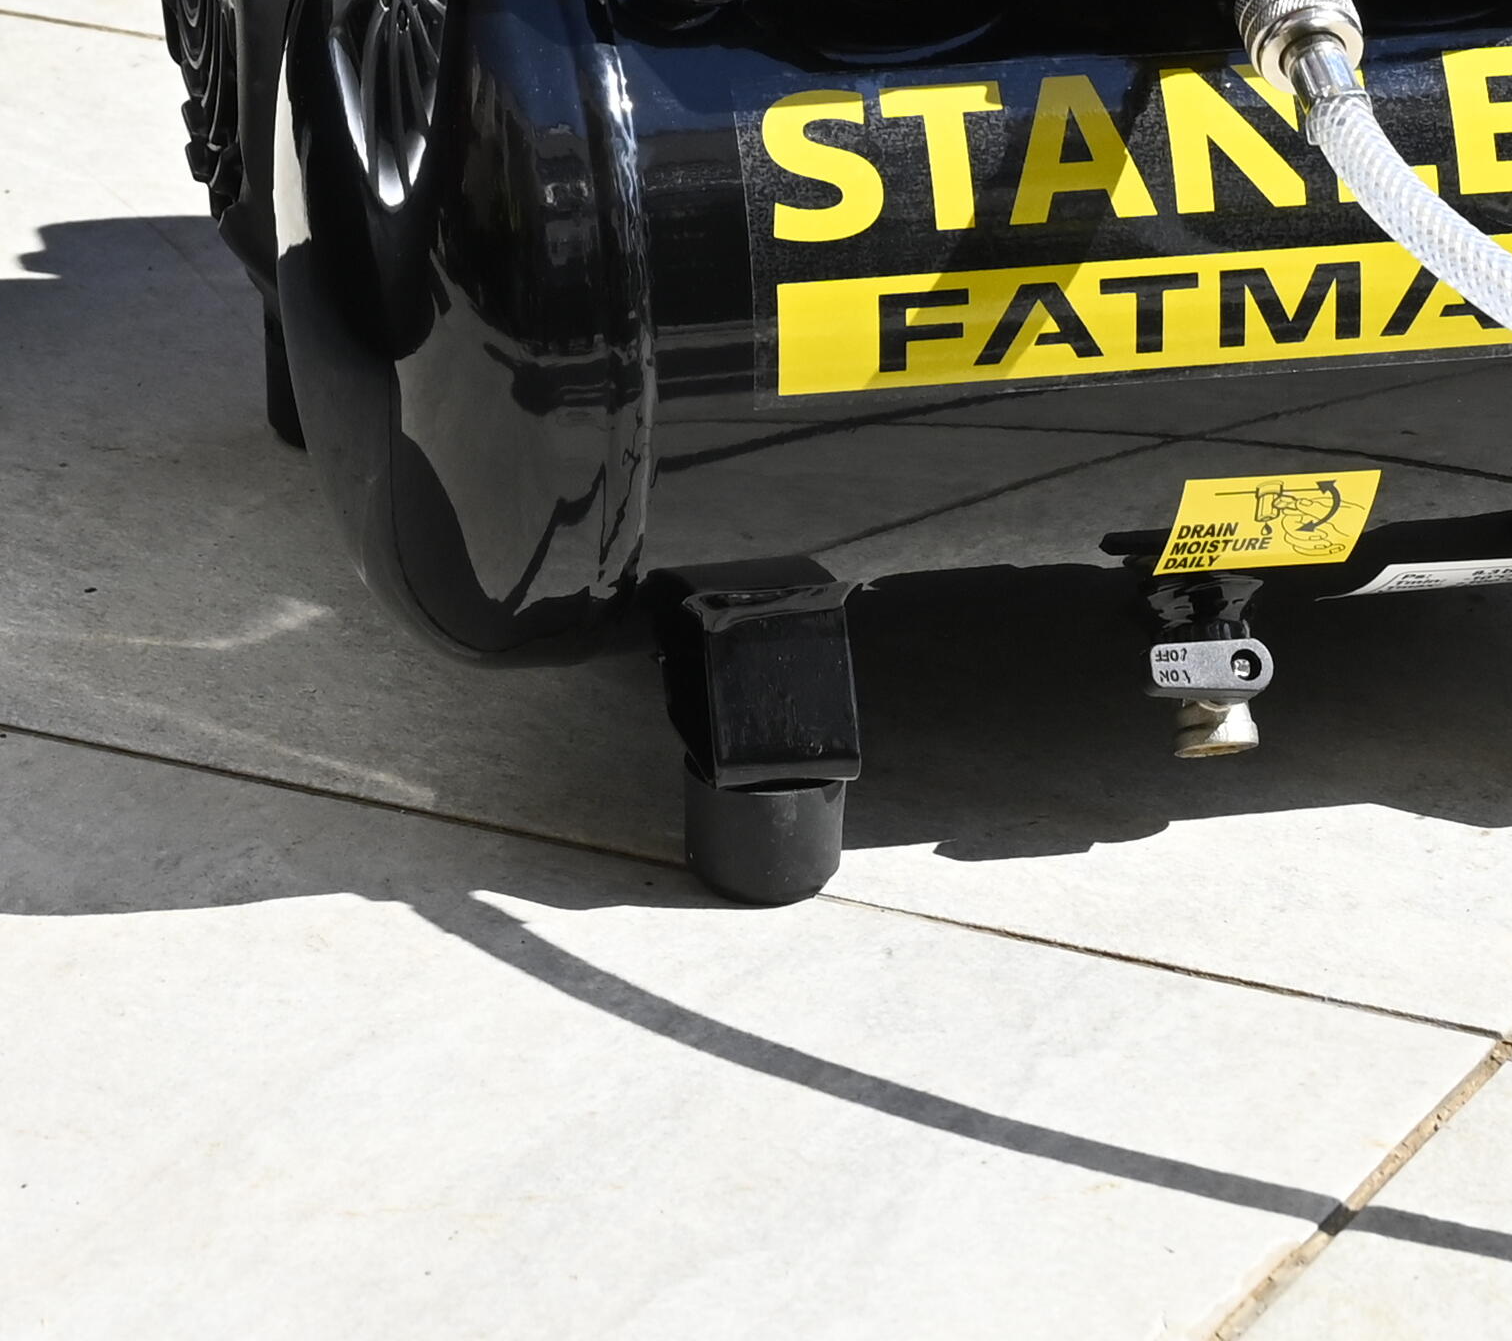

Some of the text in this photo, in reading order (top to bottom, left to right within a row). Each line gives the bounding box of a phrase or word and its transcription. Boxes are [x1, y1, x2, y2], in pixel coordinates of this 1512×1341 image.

[1177, 522, 1239, 540] DRAIN
[1170, 537, 1273, 556] MOISTURE
[1163, 555, 1220, 570] DAILY
